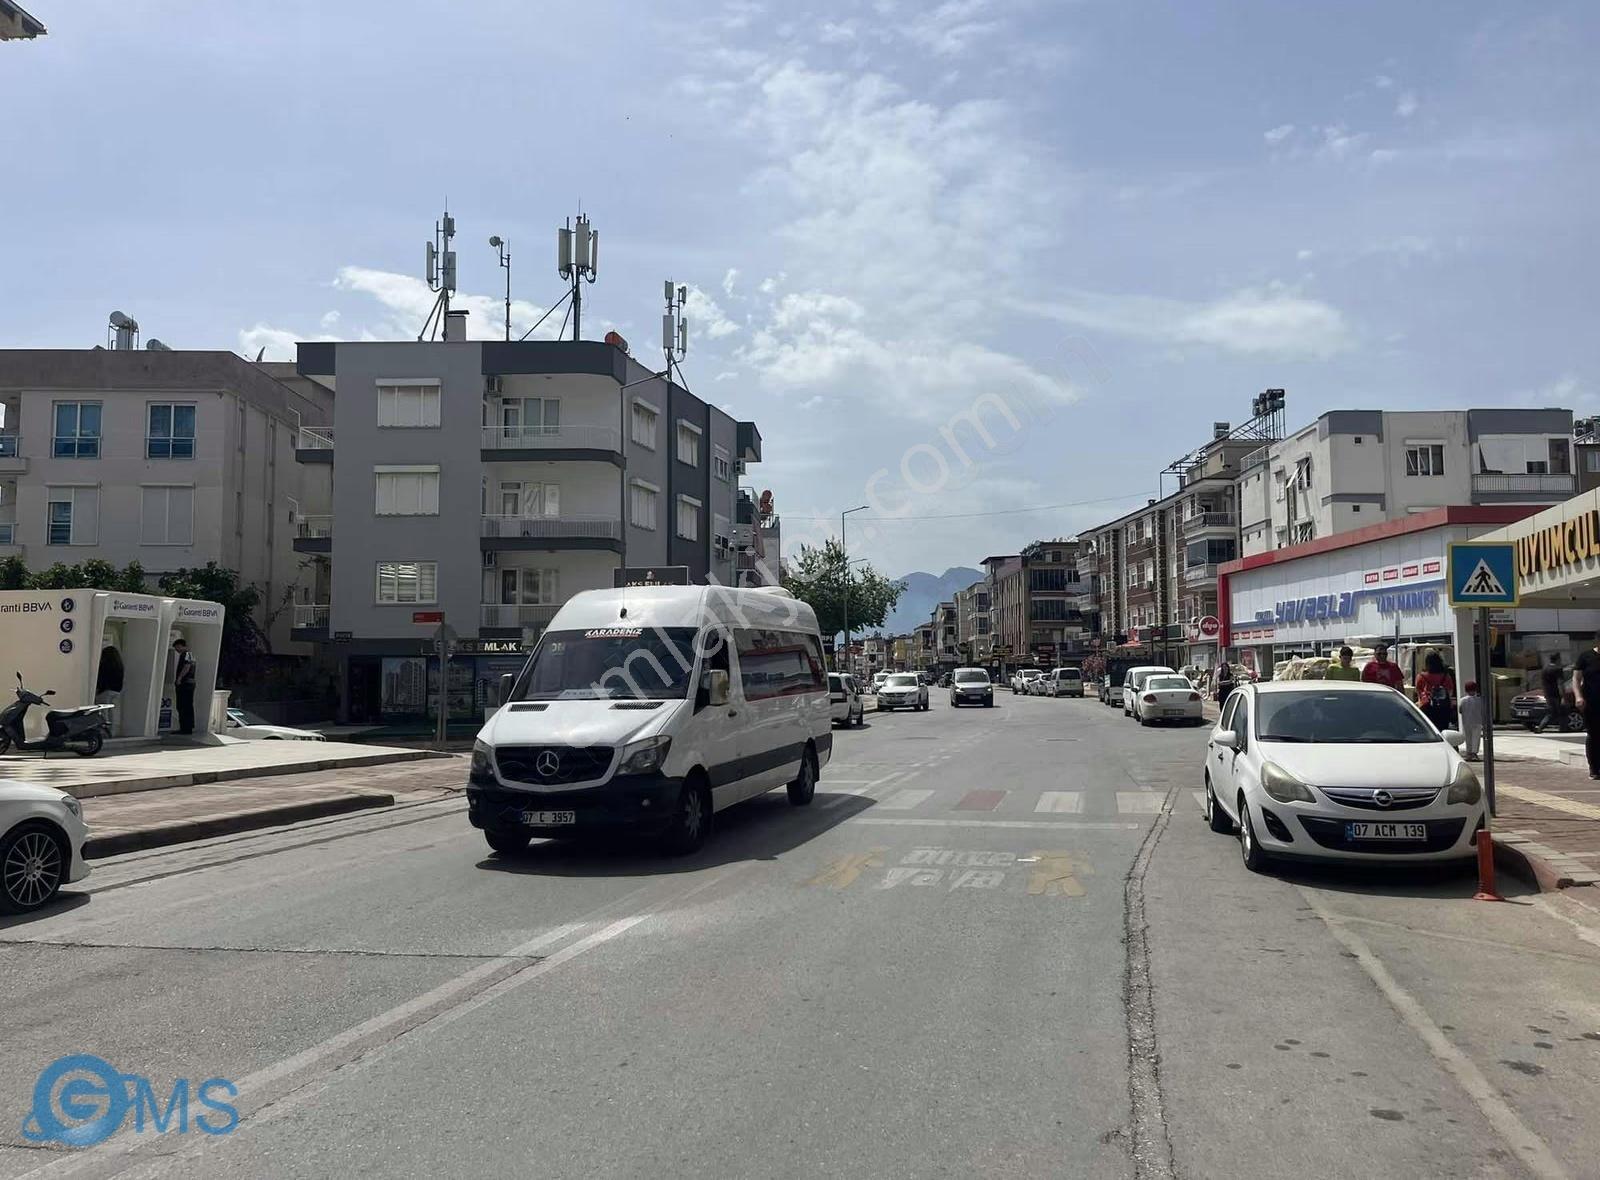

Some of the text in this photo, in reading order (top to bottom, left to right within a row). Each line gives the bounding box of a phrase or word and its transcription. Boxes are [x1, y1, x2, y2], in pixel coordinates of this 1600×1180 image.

[23, 602, 52, 612] BBVA
[138, 604, 154, 612] BBVA
[202, 609, 218, 617] BBVA
[539, 812, 545, 822] C
[552, 812, 574, 822] 3957
[1354, 824, 1425, 837] 07 ACM 139
